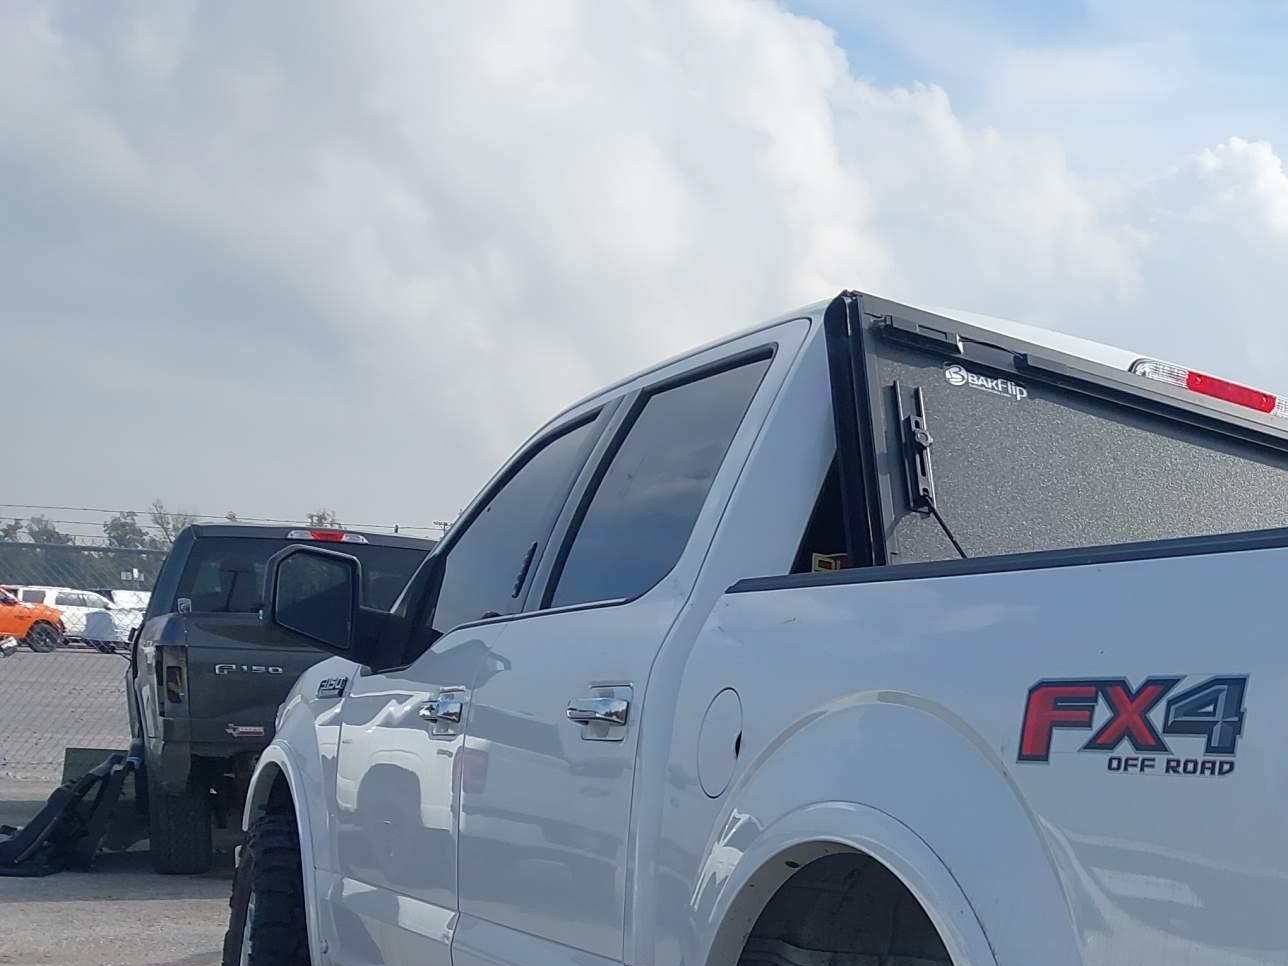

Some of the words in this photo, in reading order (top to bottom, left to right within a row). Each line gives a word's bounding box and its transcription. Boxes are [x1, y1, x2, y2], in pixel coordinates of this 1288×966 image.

[1016, 673, 1250, 764] FX4
[1107, 755, 1157, 773] OFF
[1164, 758, 1236, 777] ROAD
